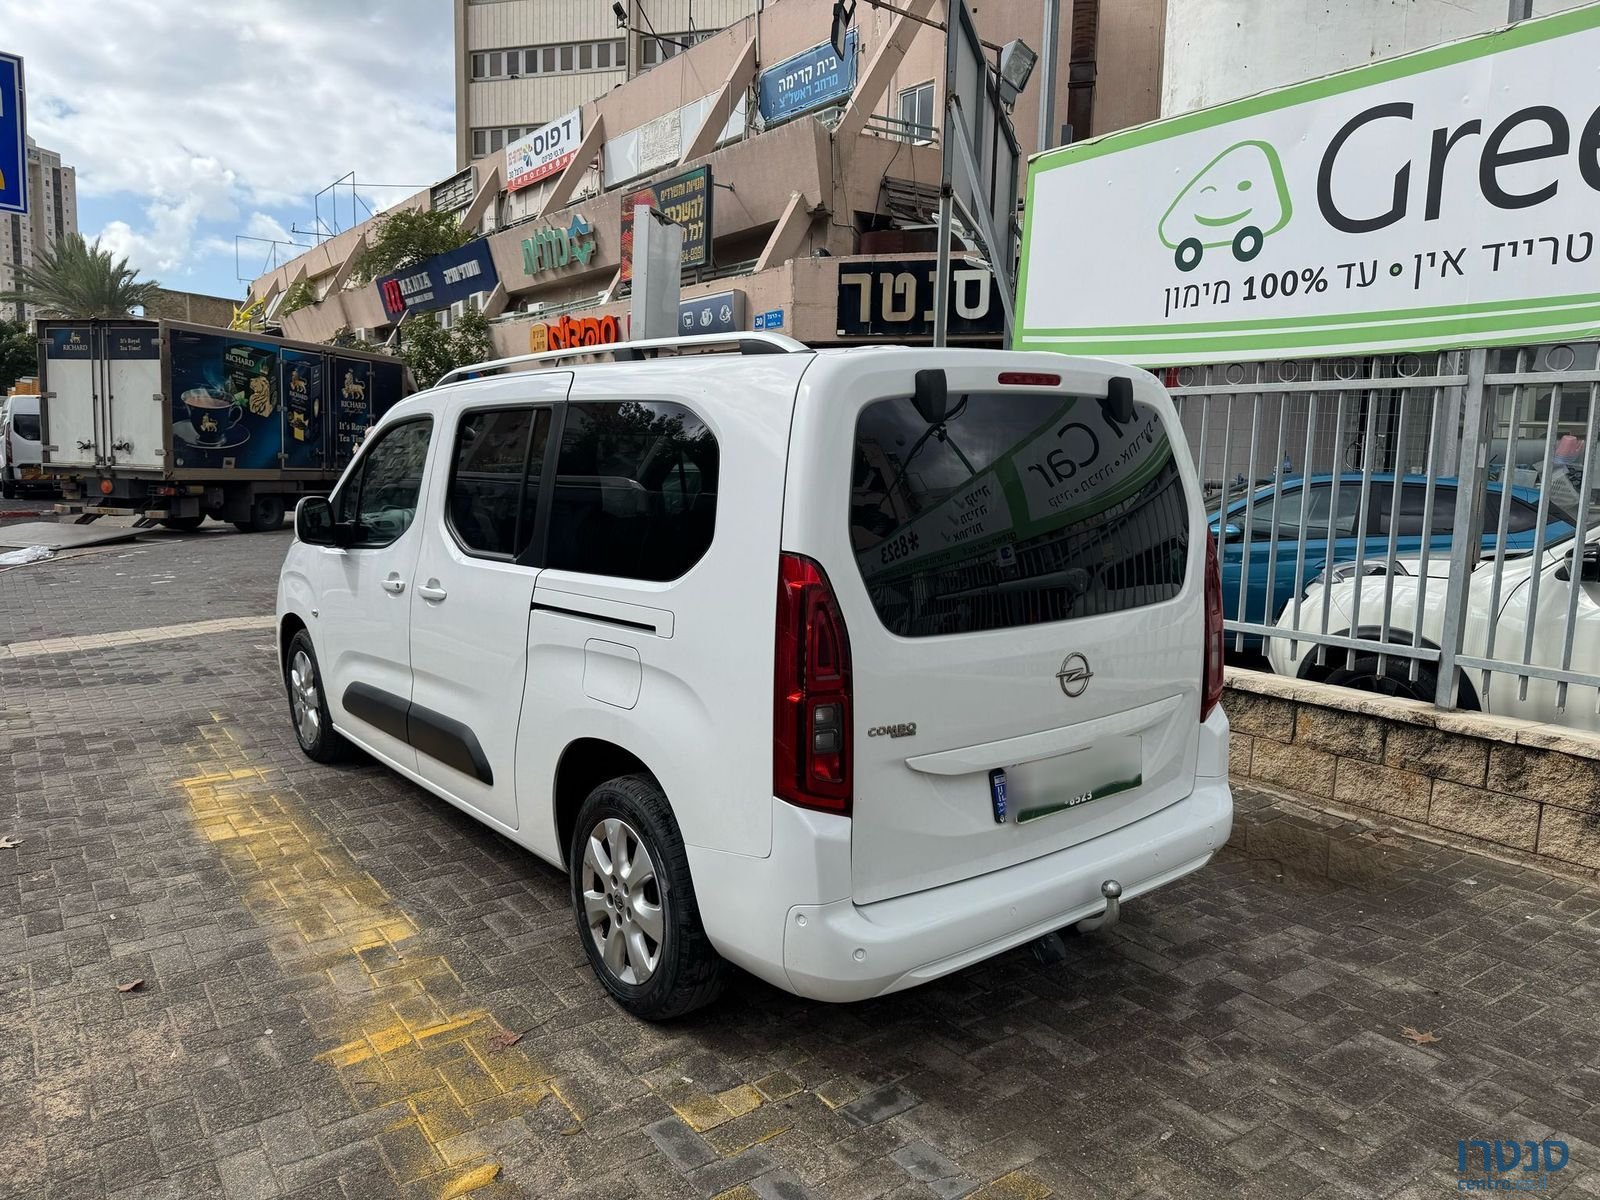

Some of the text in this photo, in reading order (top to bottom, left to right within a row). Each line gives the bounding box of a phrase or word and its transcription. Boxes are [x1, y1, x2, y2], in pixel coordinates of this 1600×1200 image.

[778, 56, 838, 93] בית קדימה
[814, 73, 839, 94] מרחב
[533, 119, 571, 156] דפוס
[1317, 95, 1600, 234] Gre
[1164, 231, 1594, 318] טרייד אין עד 100% מימון
[755, 317, 763, 326] 30
[225, 353, 255, 367] RICHARD
[341, 400, 367, 409] RICHARD
[339, 421, 350, 430] It's
[338, 433, 365, 443] Tea Tim
[867, 722, 917, 738] COMBO
